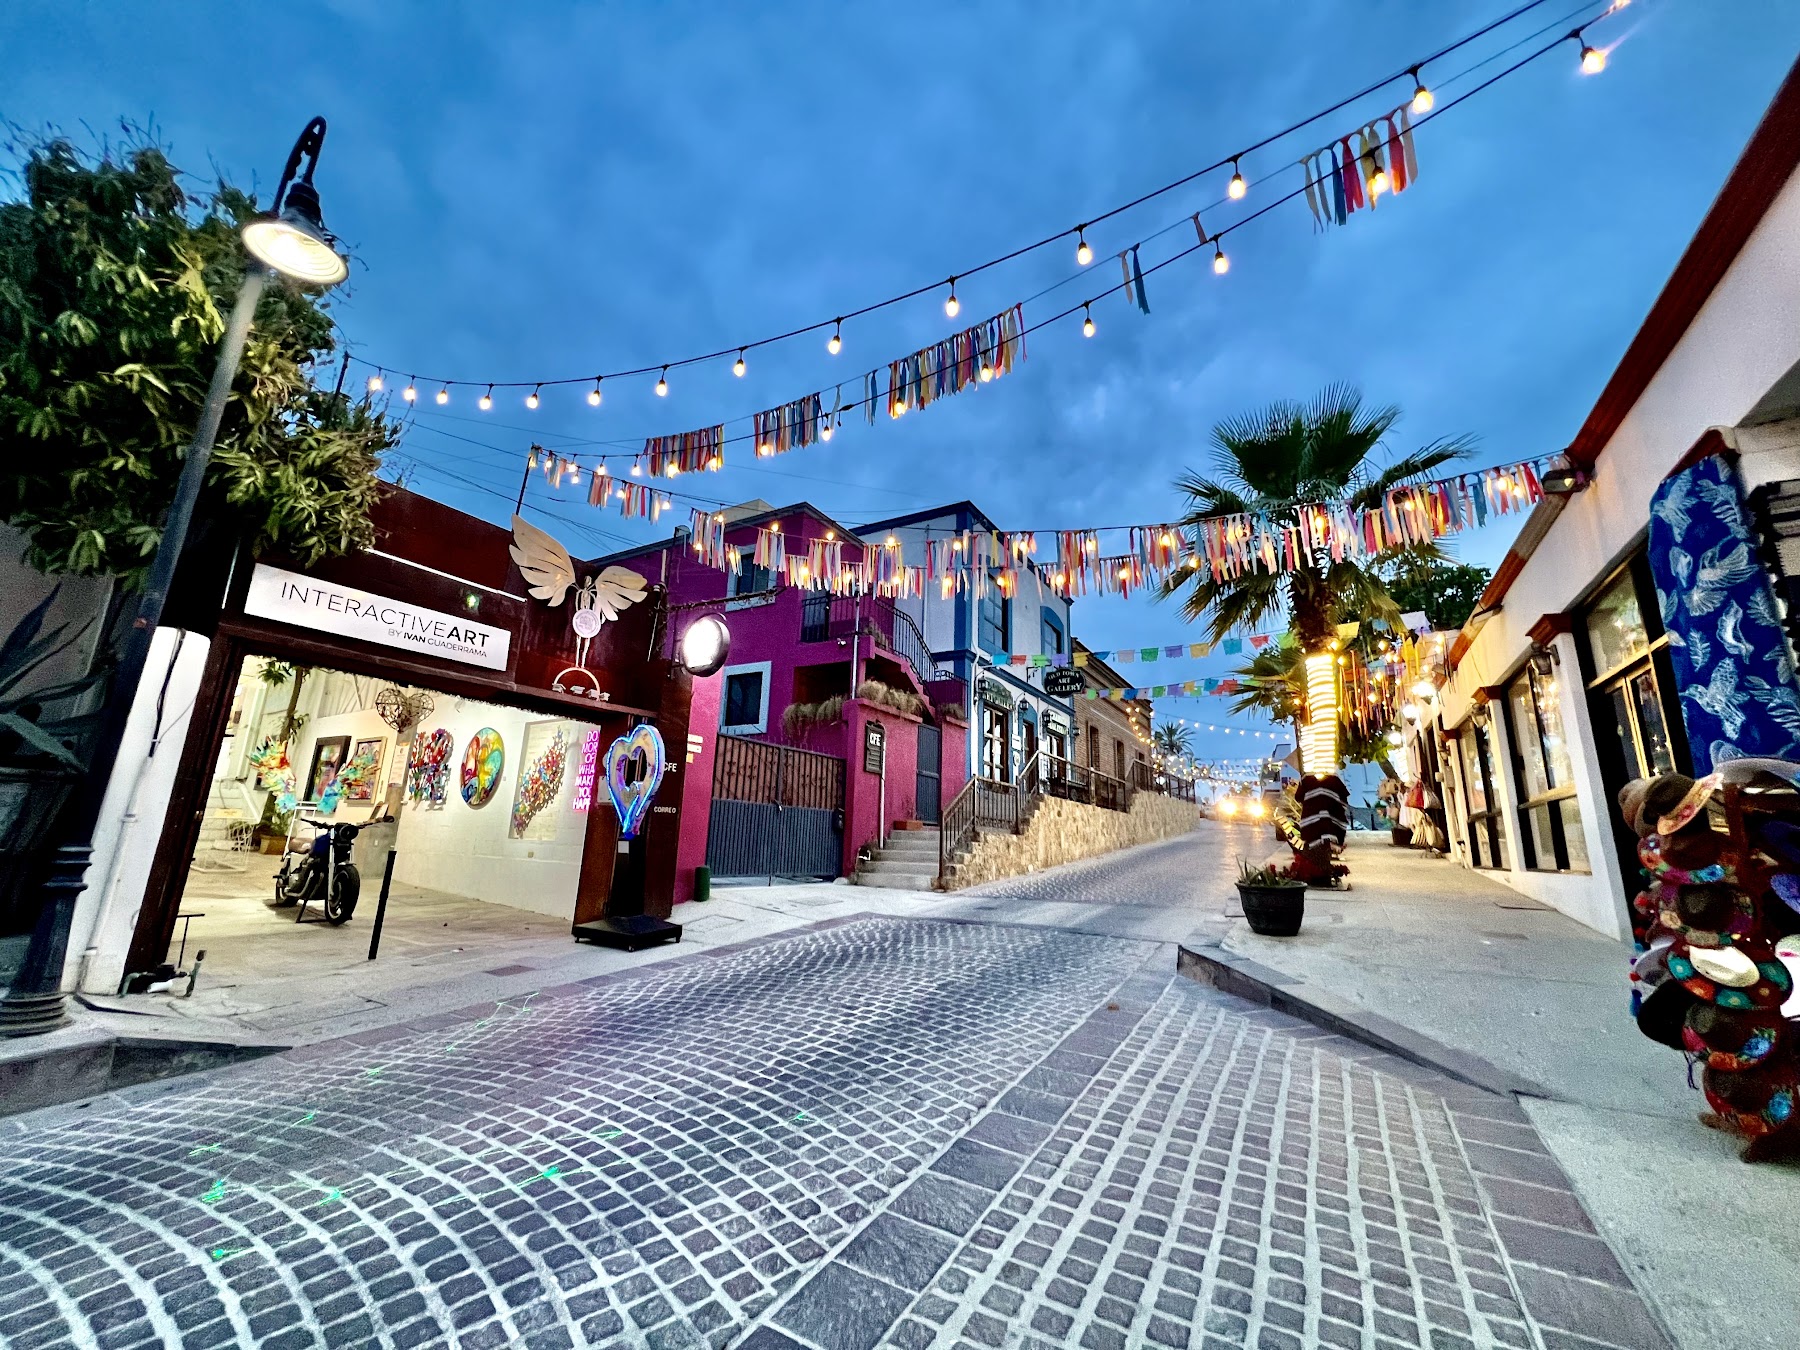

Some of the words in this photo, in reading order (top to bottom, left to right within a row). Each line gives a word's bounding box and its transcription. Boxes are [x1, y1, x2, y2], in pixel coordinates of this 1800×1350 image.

[281, 581, 490, 648] INTERACTIVEART
[388, 628, 401, 638] BY
[403, 632, 426, 644] IVAN
[427, 637, 488, 658] CUADERRAMA
[1046, 682, 1082, 693] GALLERY
[587, 730, 599, 742] DO
[653, 805, 677, 814] CORREO
